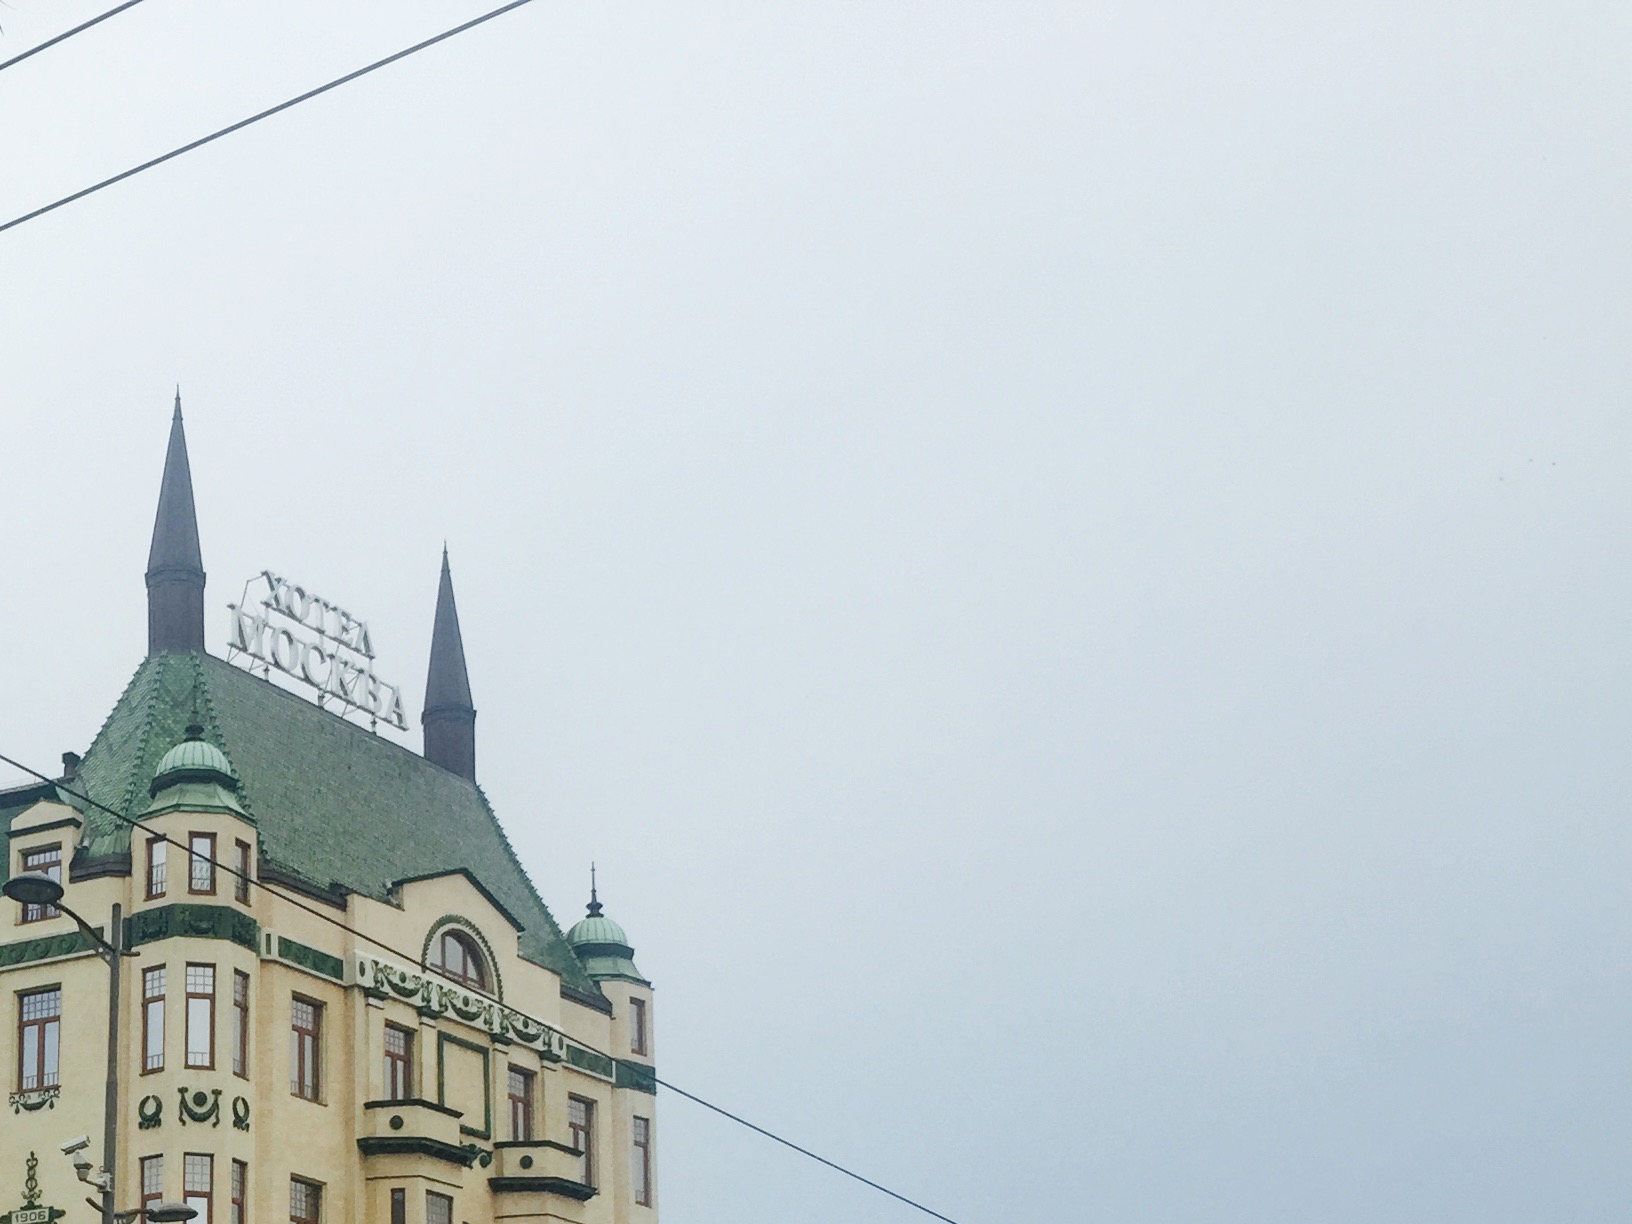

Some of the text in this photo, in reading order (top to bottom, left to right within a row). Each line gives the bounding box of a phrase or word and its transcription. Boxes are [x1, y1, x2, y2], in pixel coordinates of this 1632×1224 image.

[260, 569, 377, 660] ХОТЕЛ
[226, 602, 410, 733] МОСКВА
[15, 1210, 46, 1223] 1906
